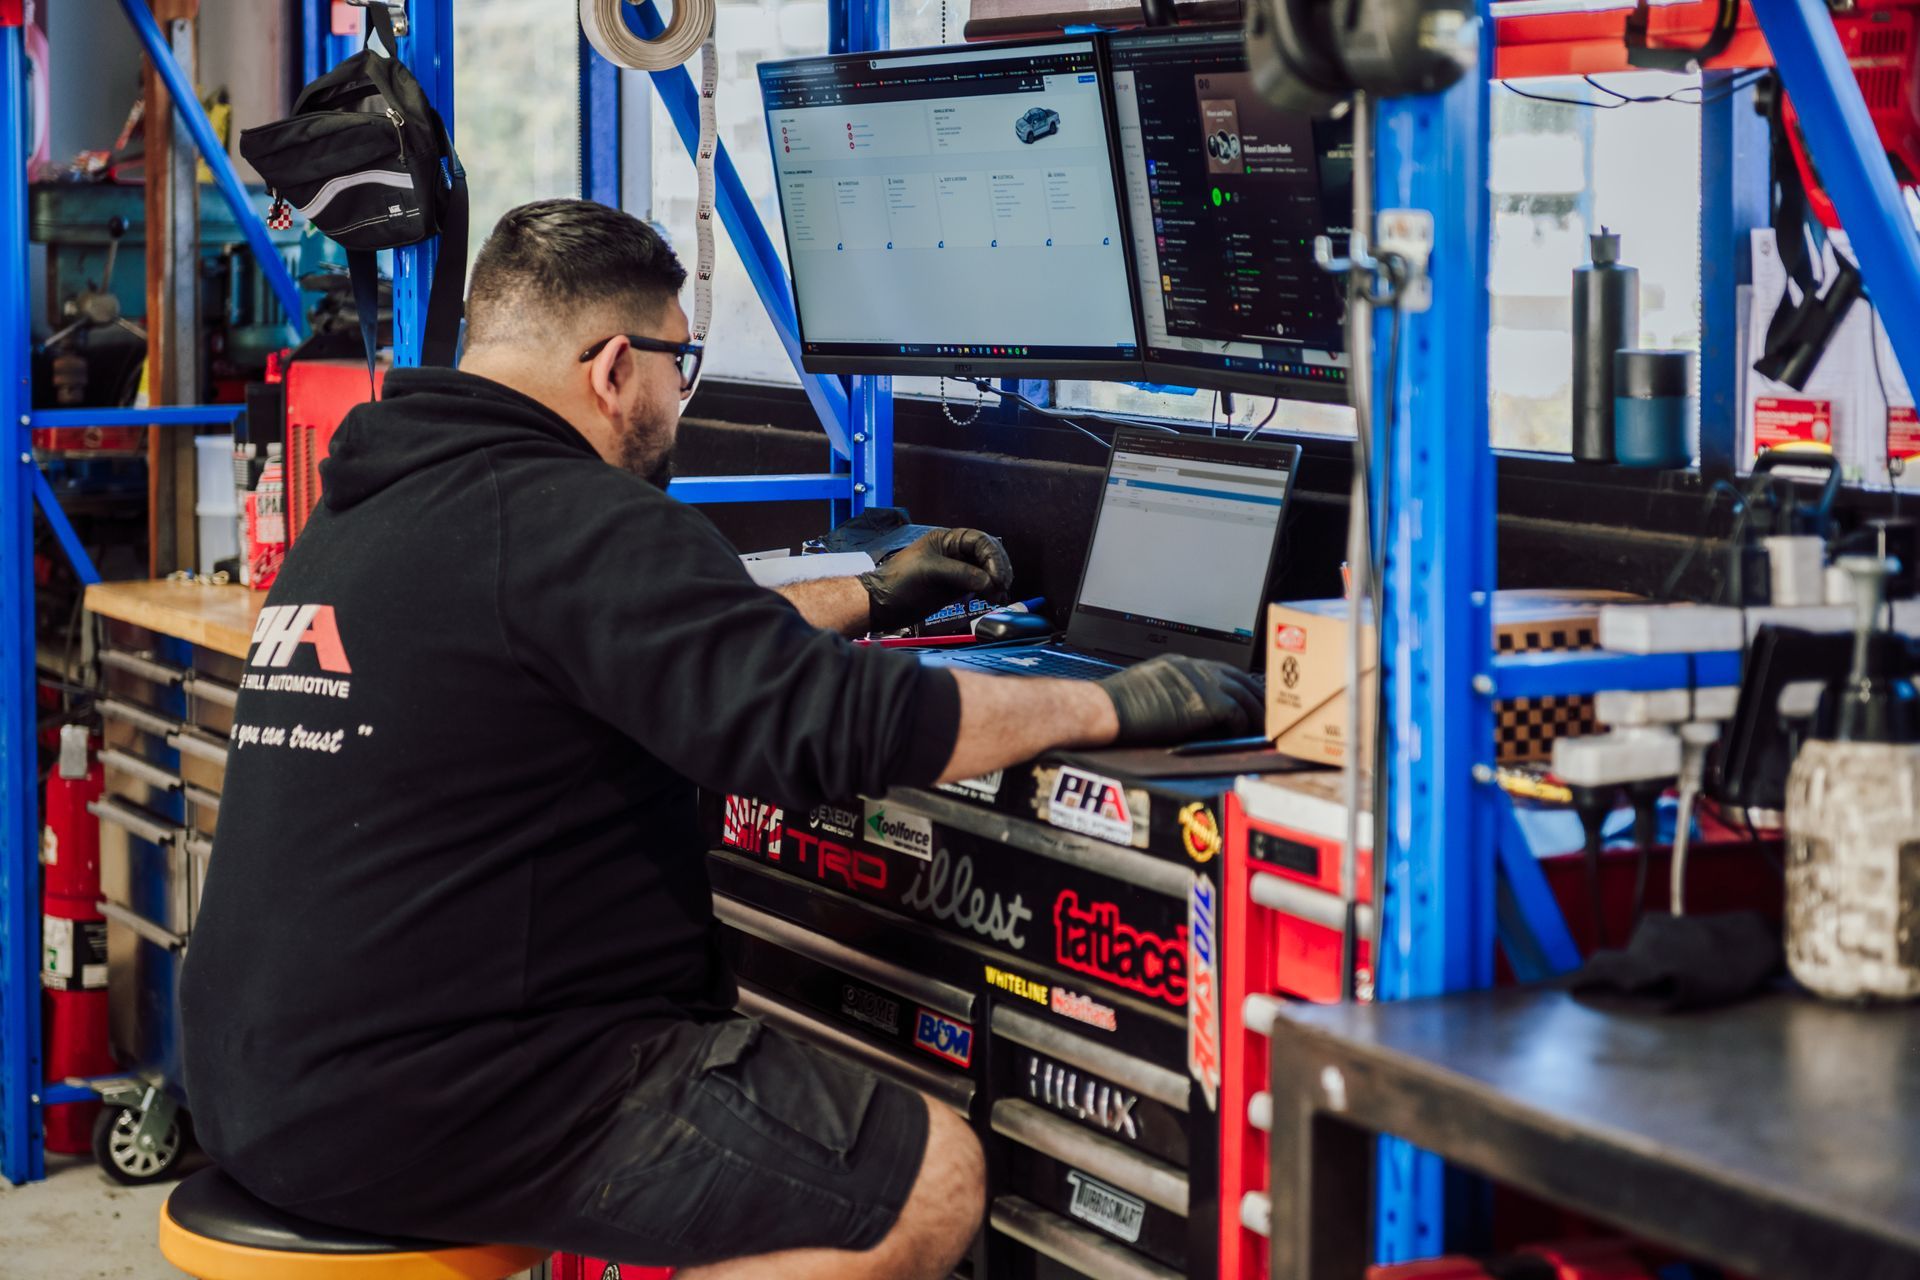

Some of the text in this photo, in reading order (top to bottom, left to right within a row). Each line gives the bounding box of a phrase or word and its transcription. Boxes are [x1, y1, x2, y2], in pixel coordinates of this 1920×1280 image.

[245, 674, 265, 690] HILL
[266, 675, 350, 699] AUTOMOTIVE
[238, 725, 260, 749] you
[261, 727, 285, 746] can
[289, 723, 345, 753] trust
[819, 804, 859, 829] EXEDY
[1055, 773, 1127, 822] PHA
[876, 815, 930, 847] Toolforce
[786, 828, 888, 891] TRD
[985, 965, 1049, 1006] WHITELINE
[917, 1012, 971, 1060] B&M
[1030, 1057, 1138, 1140] HILUX
